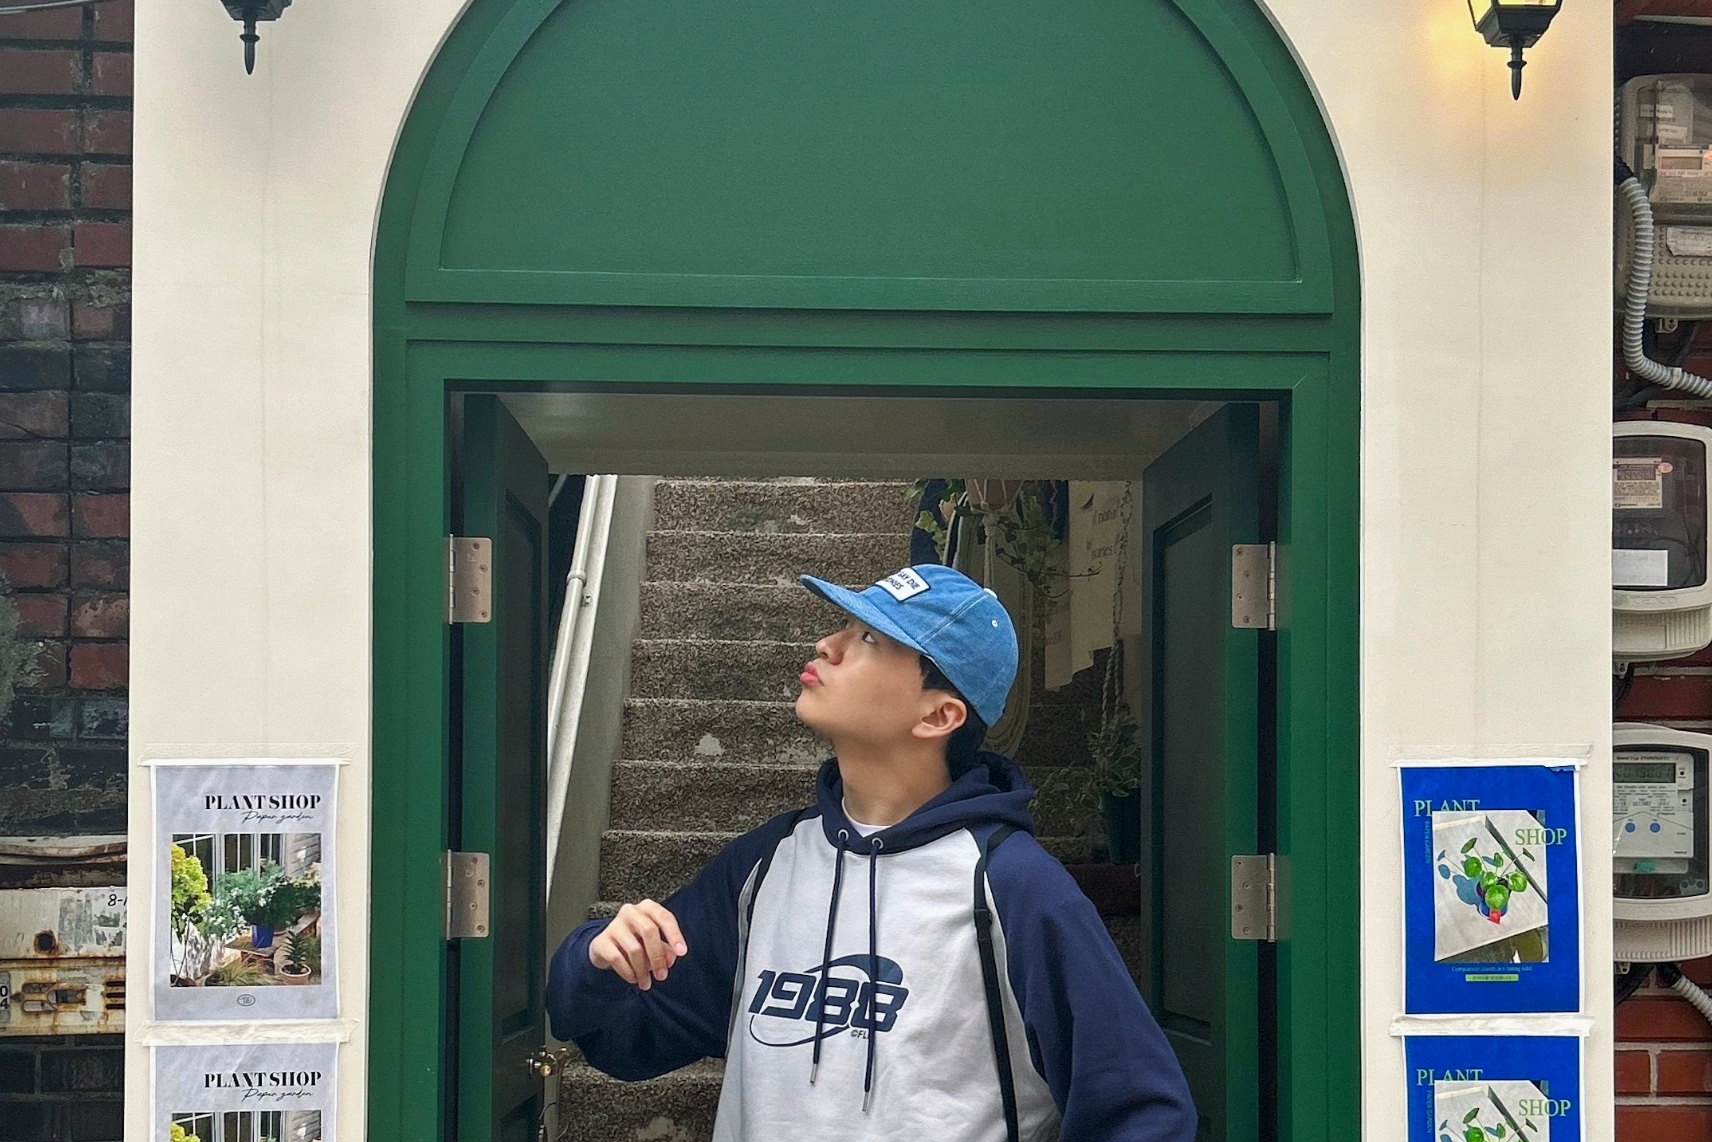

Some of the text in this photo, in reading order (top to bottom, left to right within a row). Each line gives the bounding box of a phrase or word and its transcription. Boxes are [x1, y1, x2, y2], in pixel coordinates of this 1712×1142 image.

[205, 794, 321, 810] PLANT SHOP
[1515, 827, 1567, 846] SHOP
[748, 969, 909, 1033] 1988
[205, 1071, 322, 1088] PLANT SHOP
[1518, 1098, 1571, 1117] SHOP
